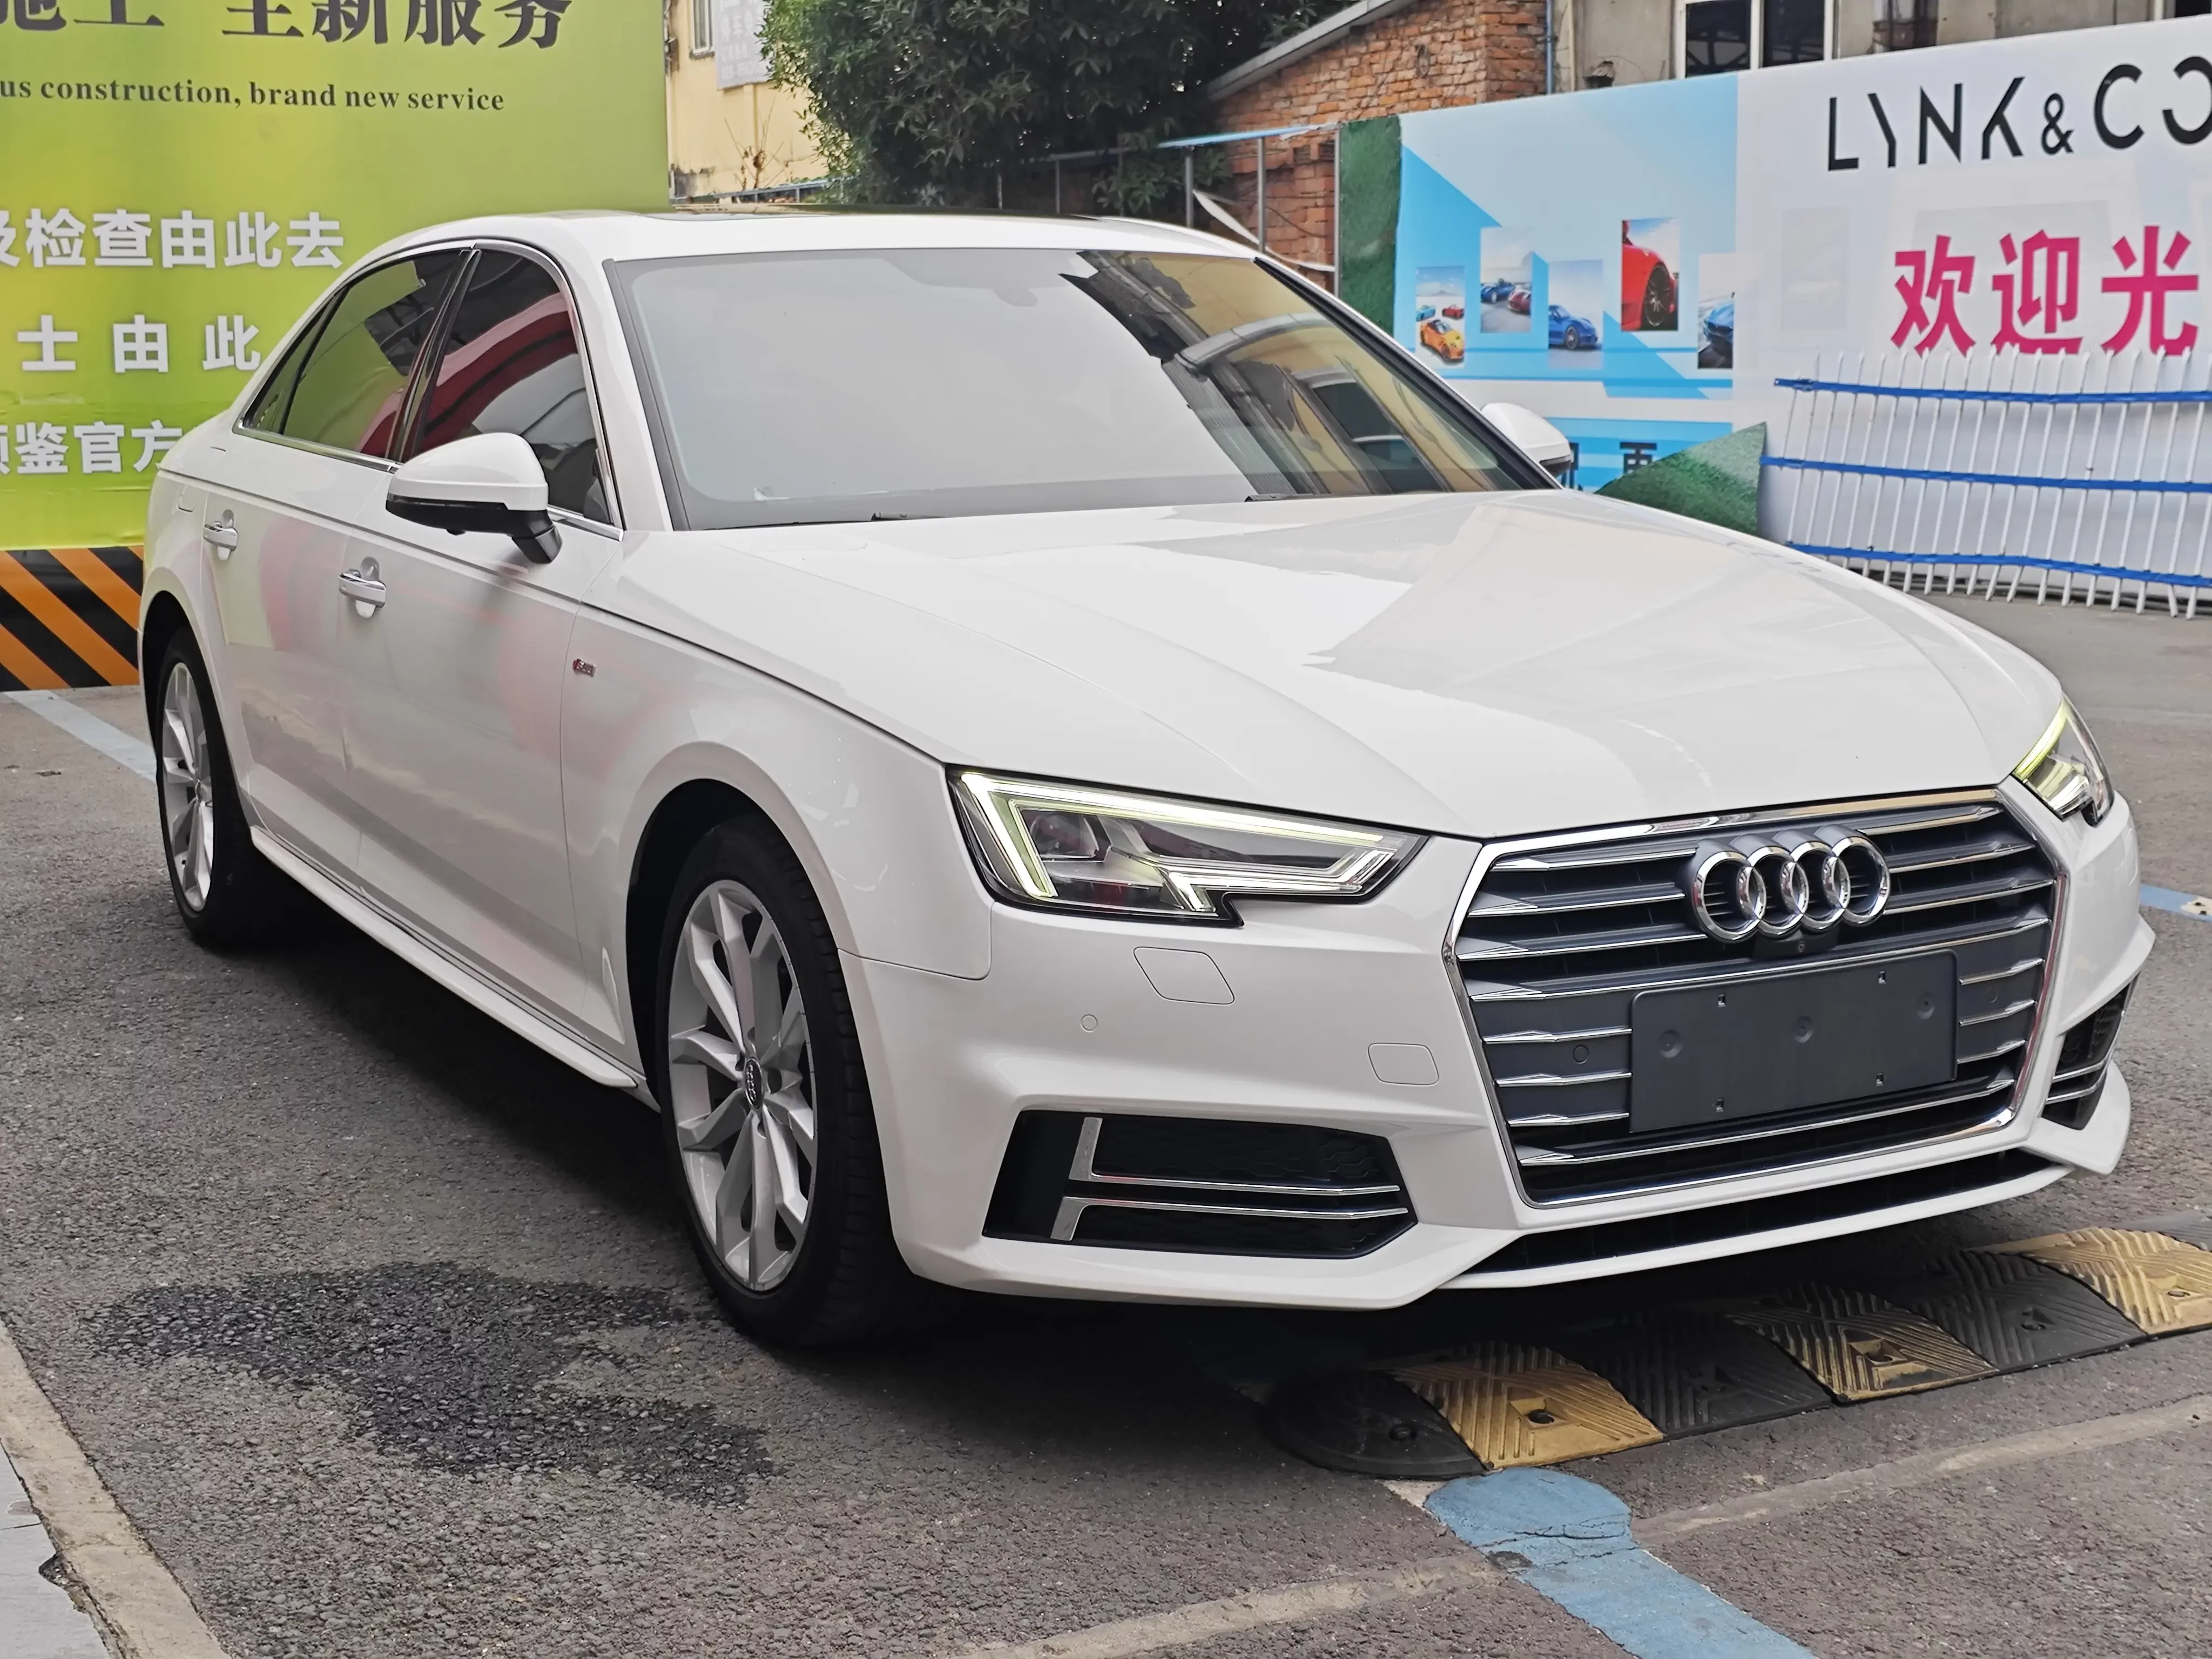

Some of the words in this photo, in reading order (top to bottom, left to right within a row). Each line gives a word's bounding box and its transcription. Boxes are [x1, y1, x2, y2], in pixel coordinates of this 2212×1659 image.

[41, 79, 241, 109] construction,
[250, 82, 336, 106] brand
[345, 89, 400, 108] new
[408, 87, 504, 111] service
[1891, 225, 2199, 359] 欢迎光
[0, 419, 185, 475] 鉴官方
